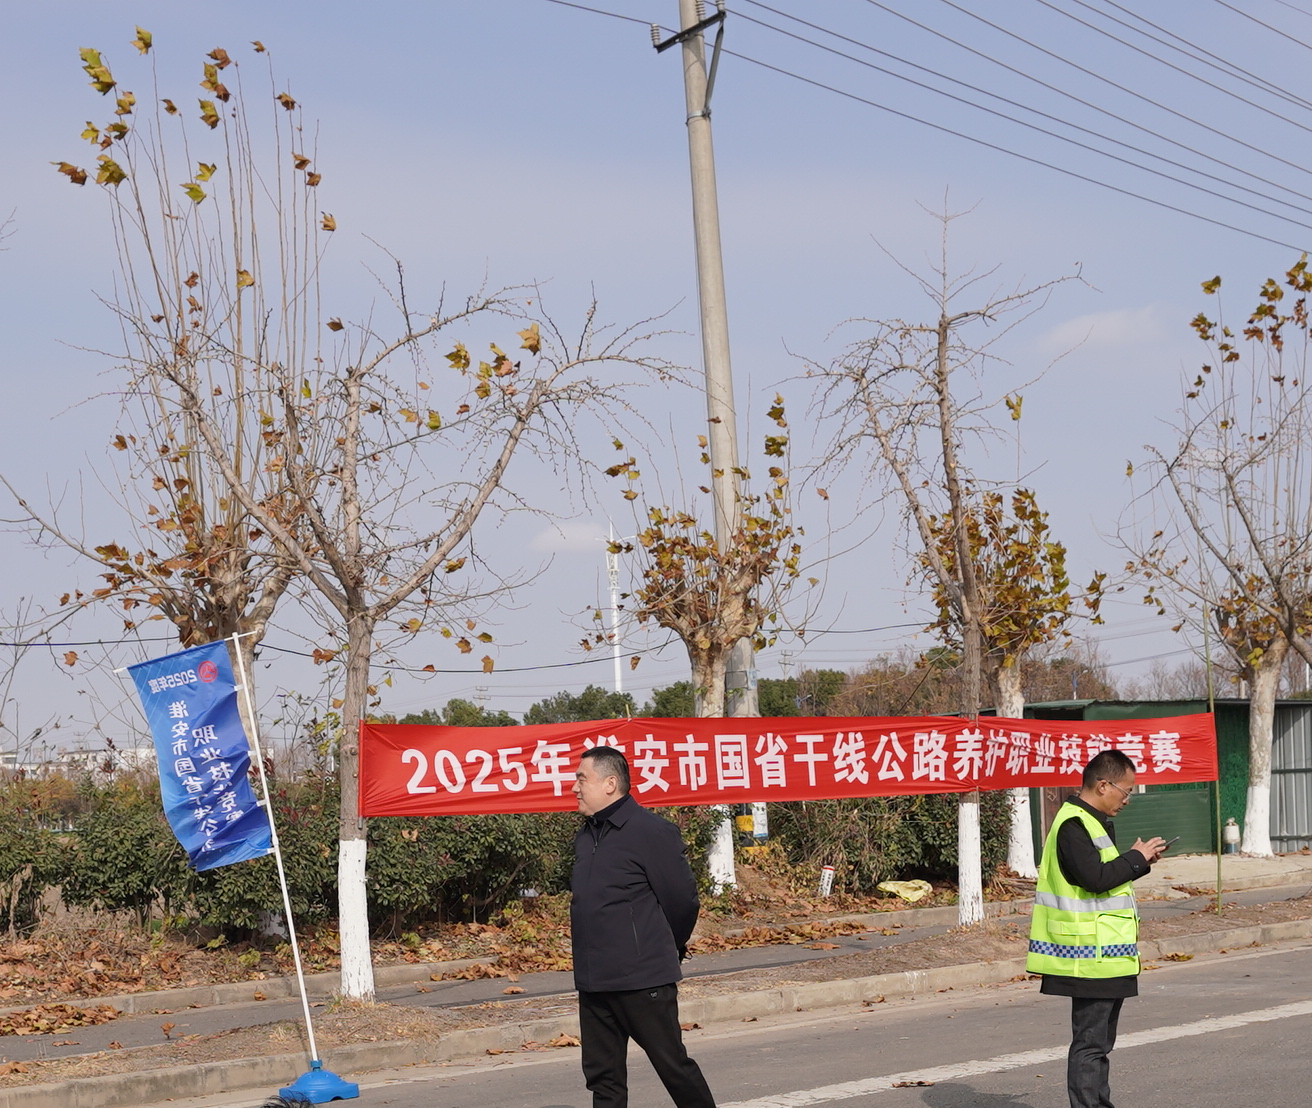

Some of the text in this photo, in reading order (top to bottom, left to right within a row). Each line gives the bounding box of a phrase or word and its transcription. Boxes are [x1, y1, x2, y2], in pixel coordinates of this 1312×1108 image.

[401, 729, 1183, 797] 2025年安市国省干线公路养护职业技竞赛
